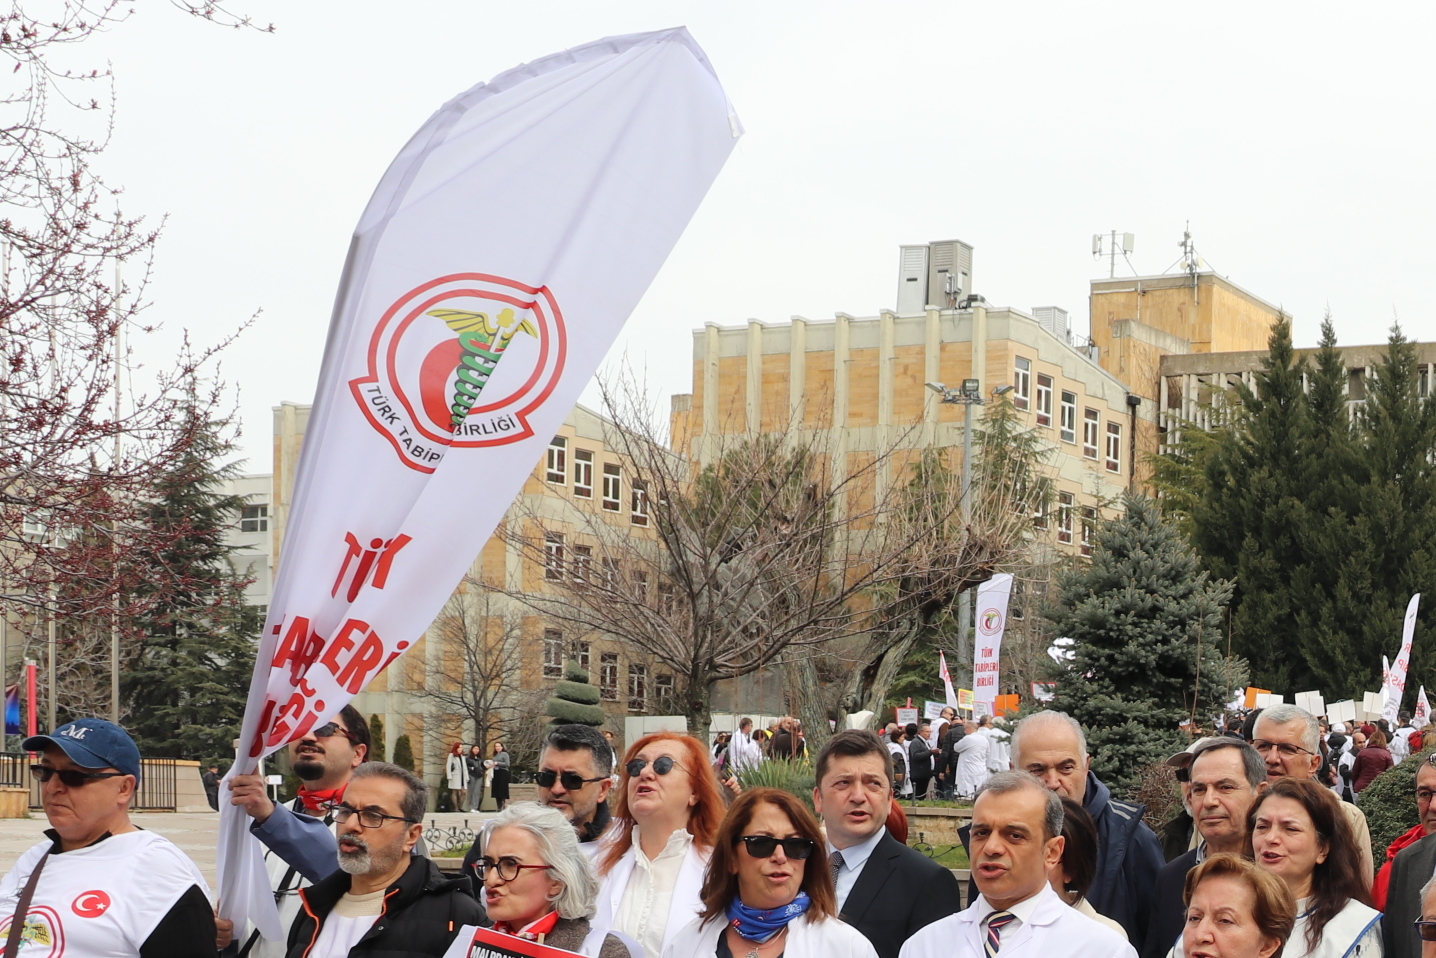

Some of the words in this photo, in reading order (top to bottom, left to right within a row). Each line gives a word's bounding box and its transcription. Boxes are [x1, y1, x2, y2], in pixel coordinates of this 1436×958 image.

[367, 385, 401, 426] TÜRK
[398, 425, 445, 464] TABİP
[451, 414, 517, 437] BİRLİĞİ
